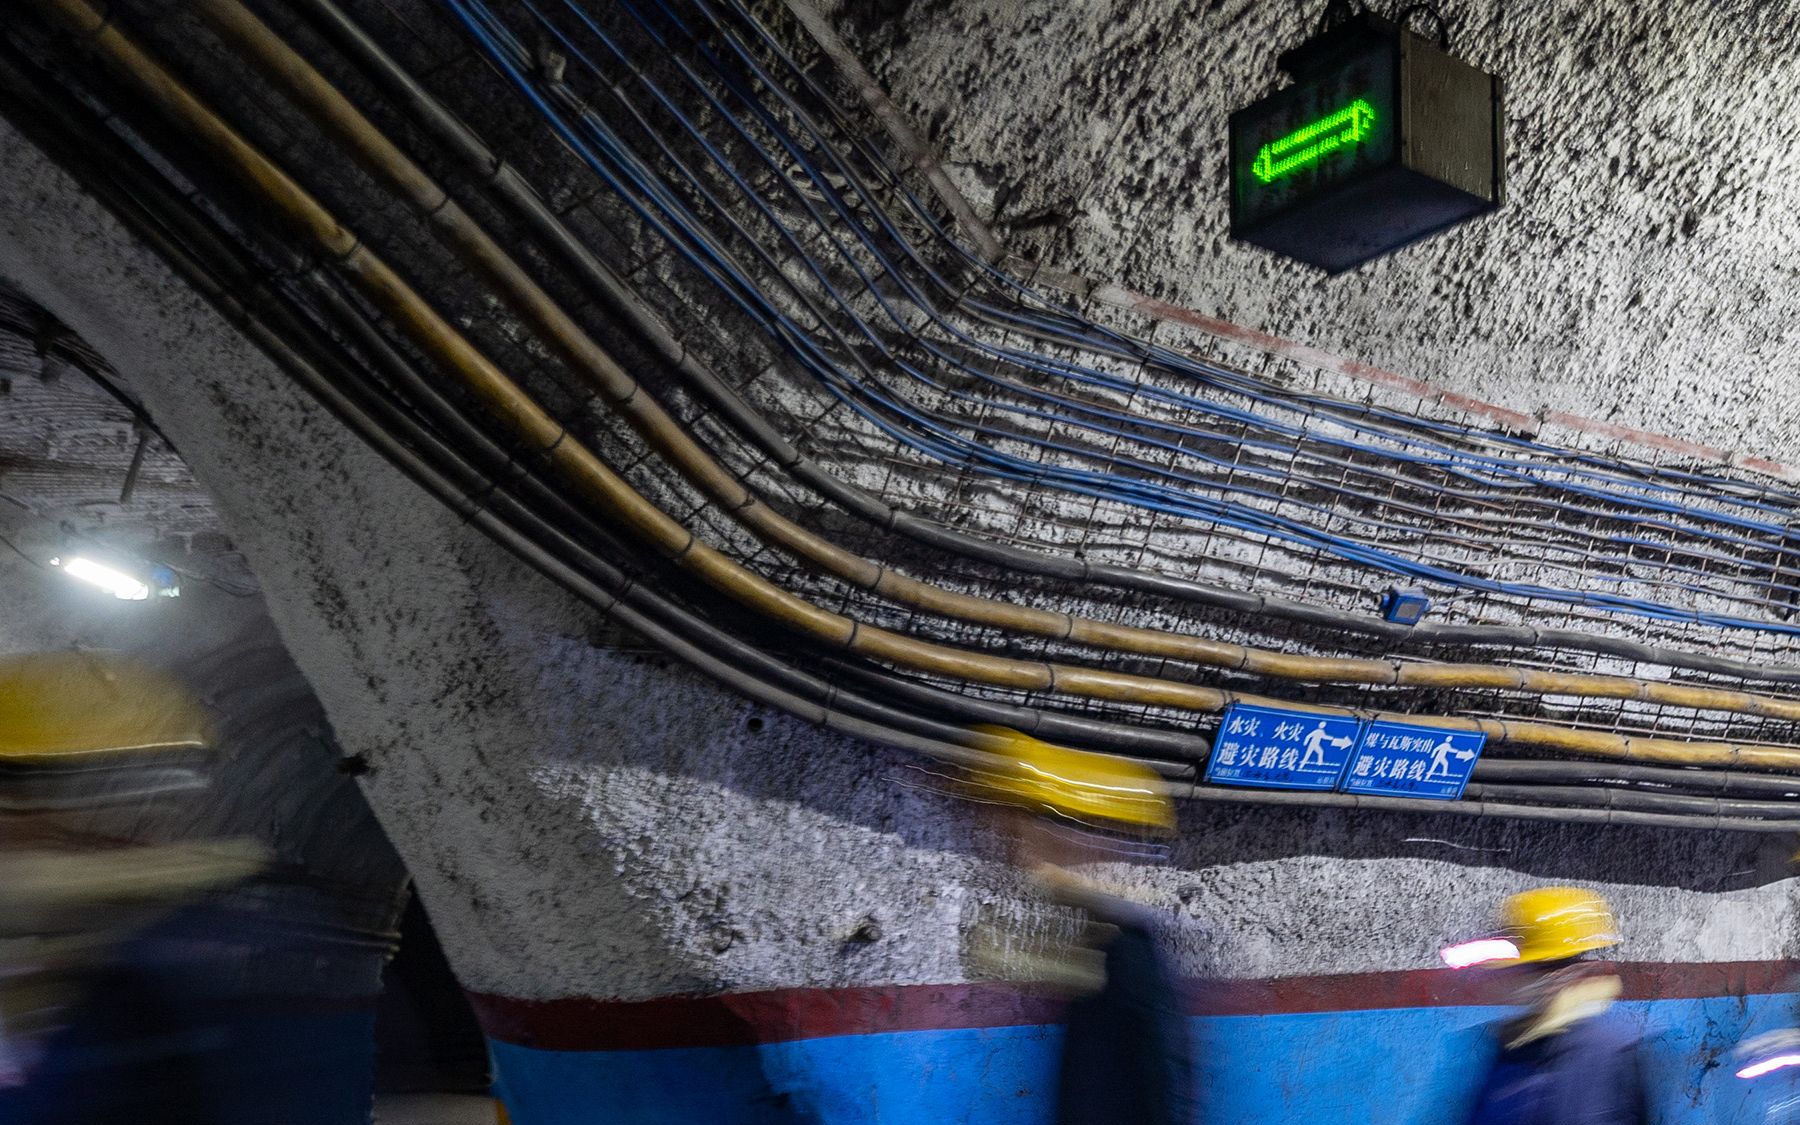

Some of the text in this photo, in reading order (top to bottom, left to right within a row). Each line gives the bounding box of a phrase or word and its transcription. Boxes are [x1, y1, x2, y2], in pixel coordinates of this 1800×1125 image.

[1364, 732, 1434, 754] 煤与瓦斯突出
[1216, 742, 1299, 771] 避灾路线
[1352, 755, 1426, 781] 避灾路线
